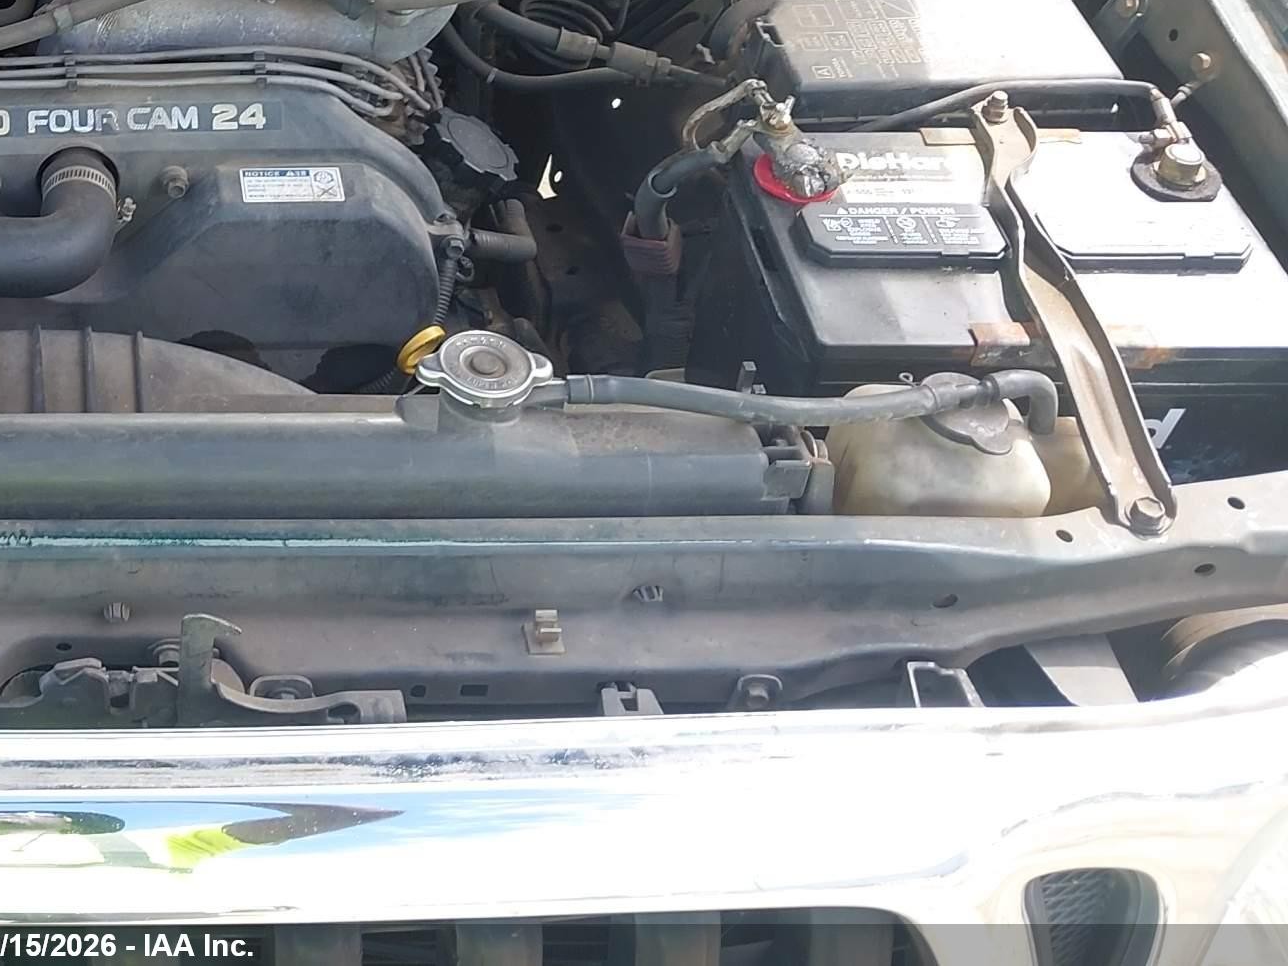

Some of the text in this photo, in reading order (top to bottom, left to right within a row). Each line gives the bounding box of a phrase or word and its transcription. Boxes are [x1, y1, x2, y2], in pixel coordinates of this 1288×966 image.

[28, 108, 120, 134] FOUR
[127, 105, 199, 131] CAM
[211, 103, 266, 131] 24
[847, 207, 899, 215] DANGER
[913, 207, 956, 215] POISON
